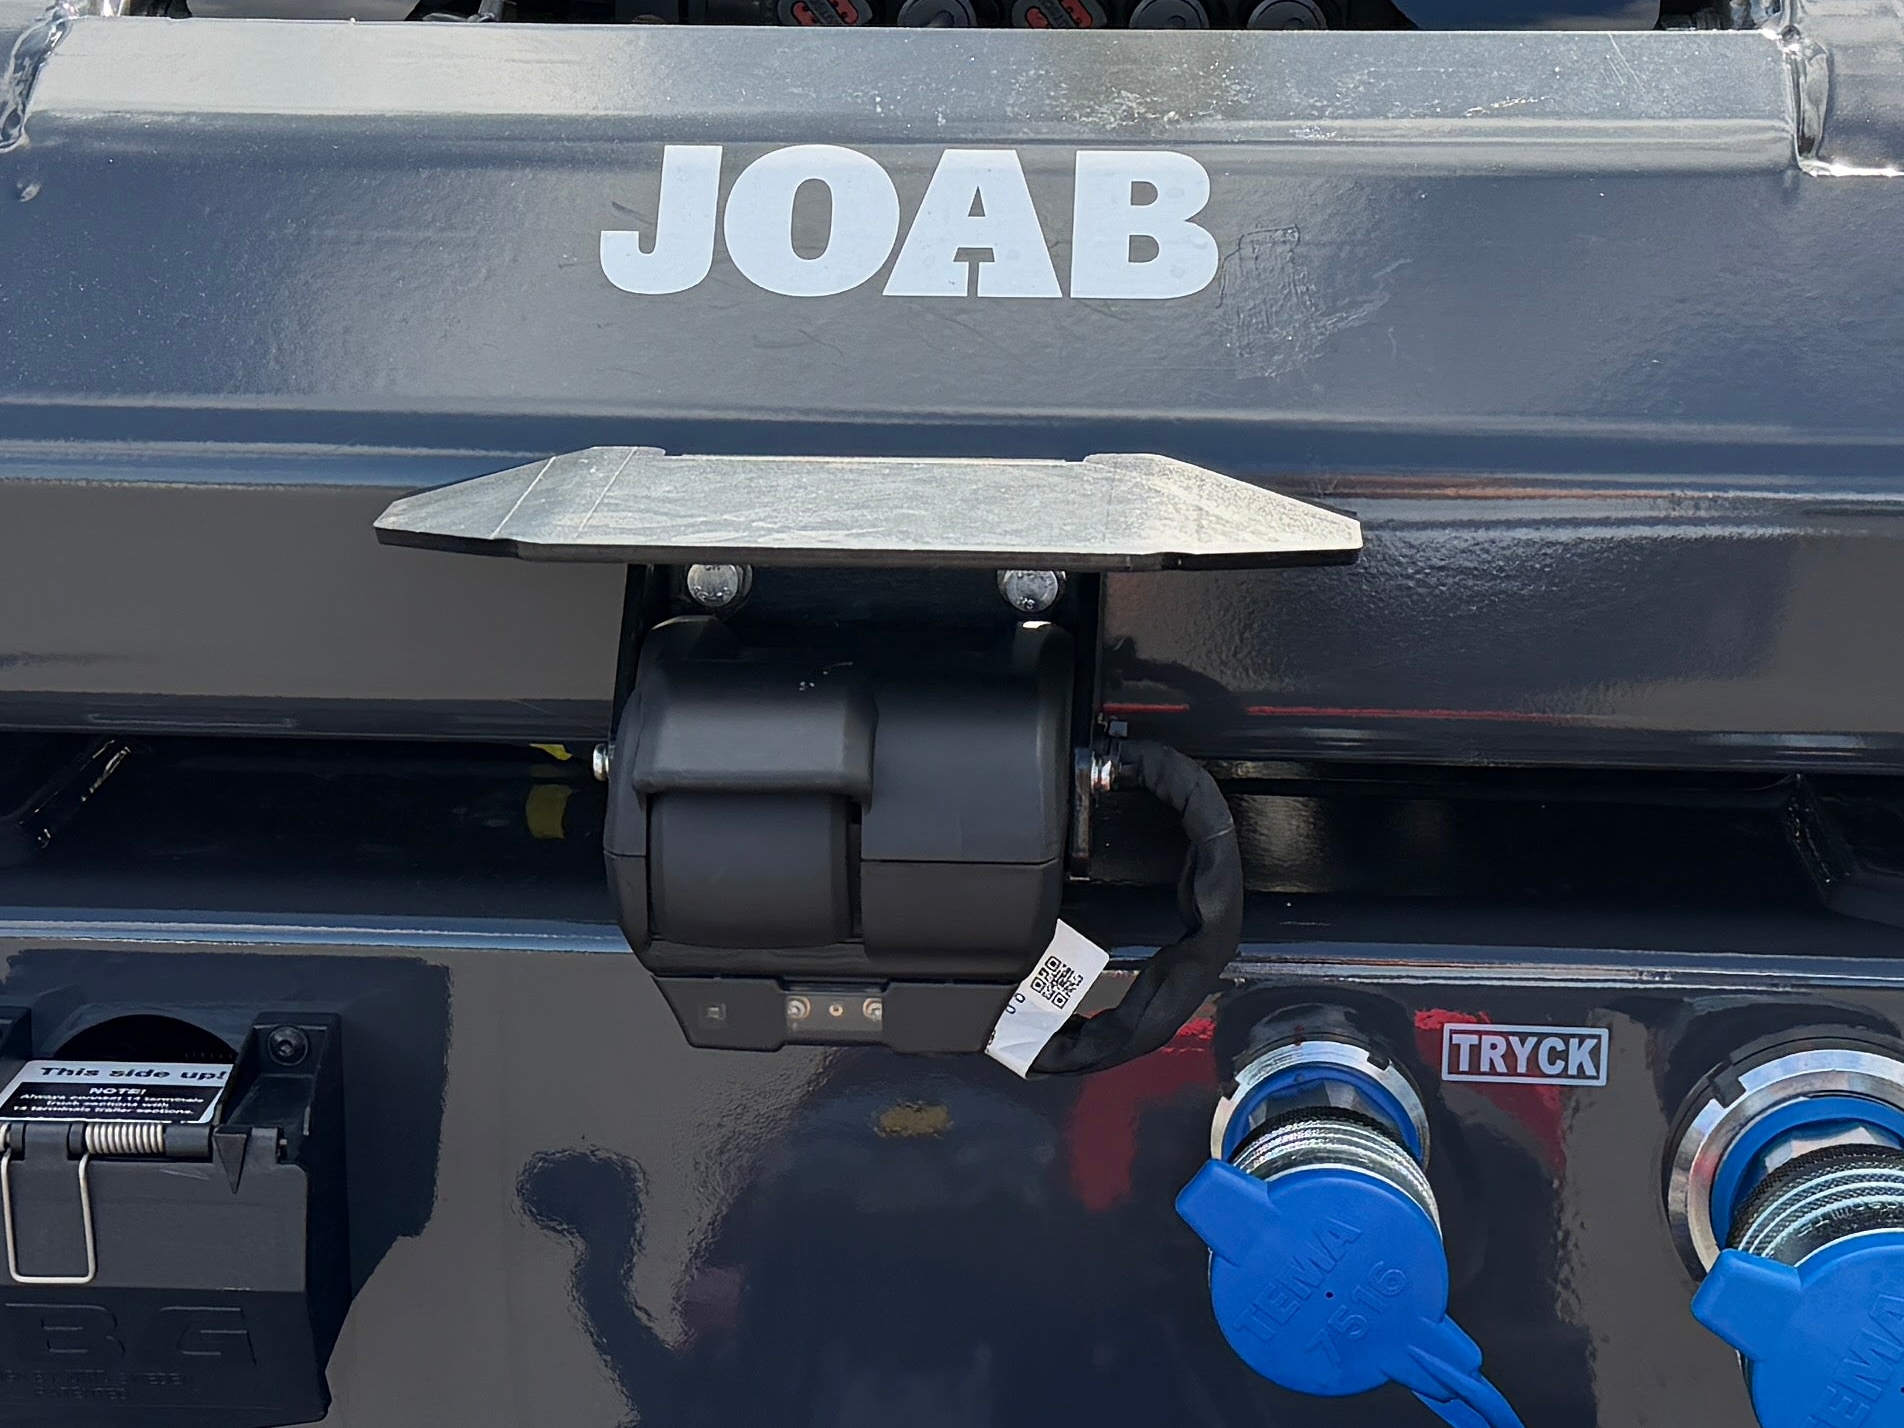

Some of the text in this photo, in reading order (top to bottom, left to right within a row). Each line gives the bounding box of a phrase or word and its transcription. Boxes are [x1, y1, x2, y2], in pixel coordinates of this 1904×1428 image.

[599, 143, 1220, 300] JOAB
[40, 1067, 227, 1081] This side up!
[88, 1087, 147, 1096] NOTE!
[1451, 1033, 1599, 1077] TRYCK
[1230, 1214, 1365, 1345] TEMA
[1303, 1259, 1409, 1368] 7516
